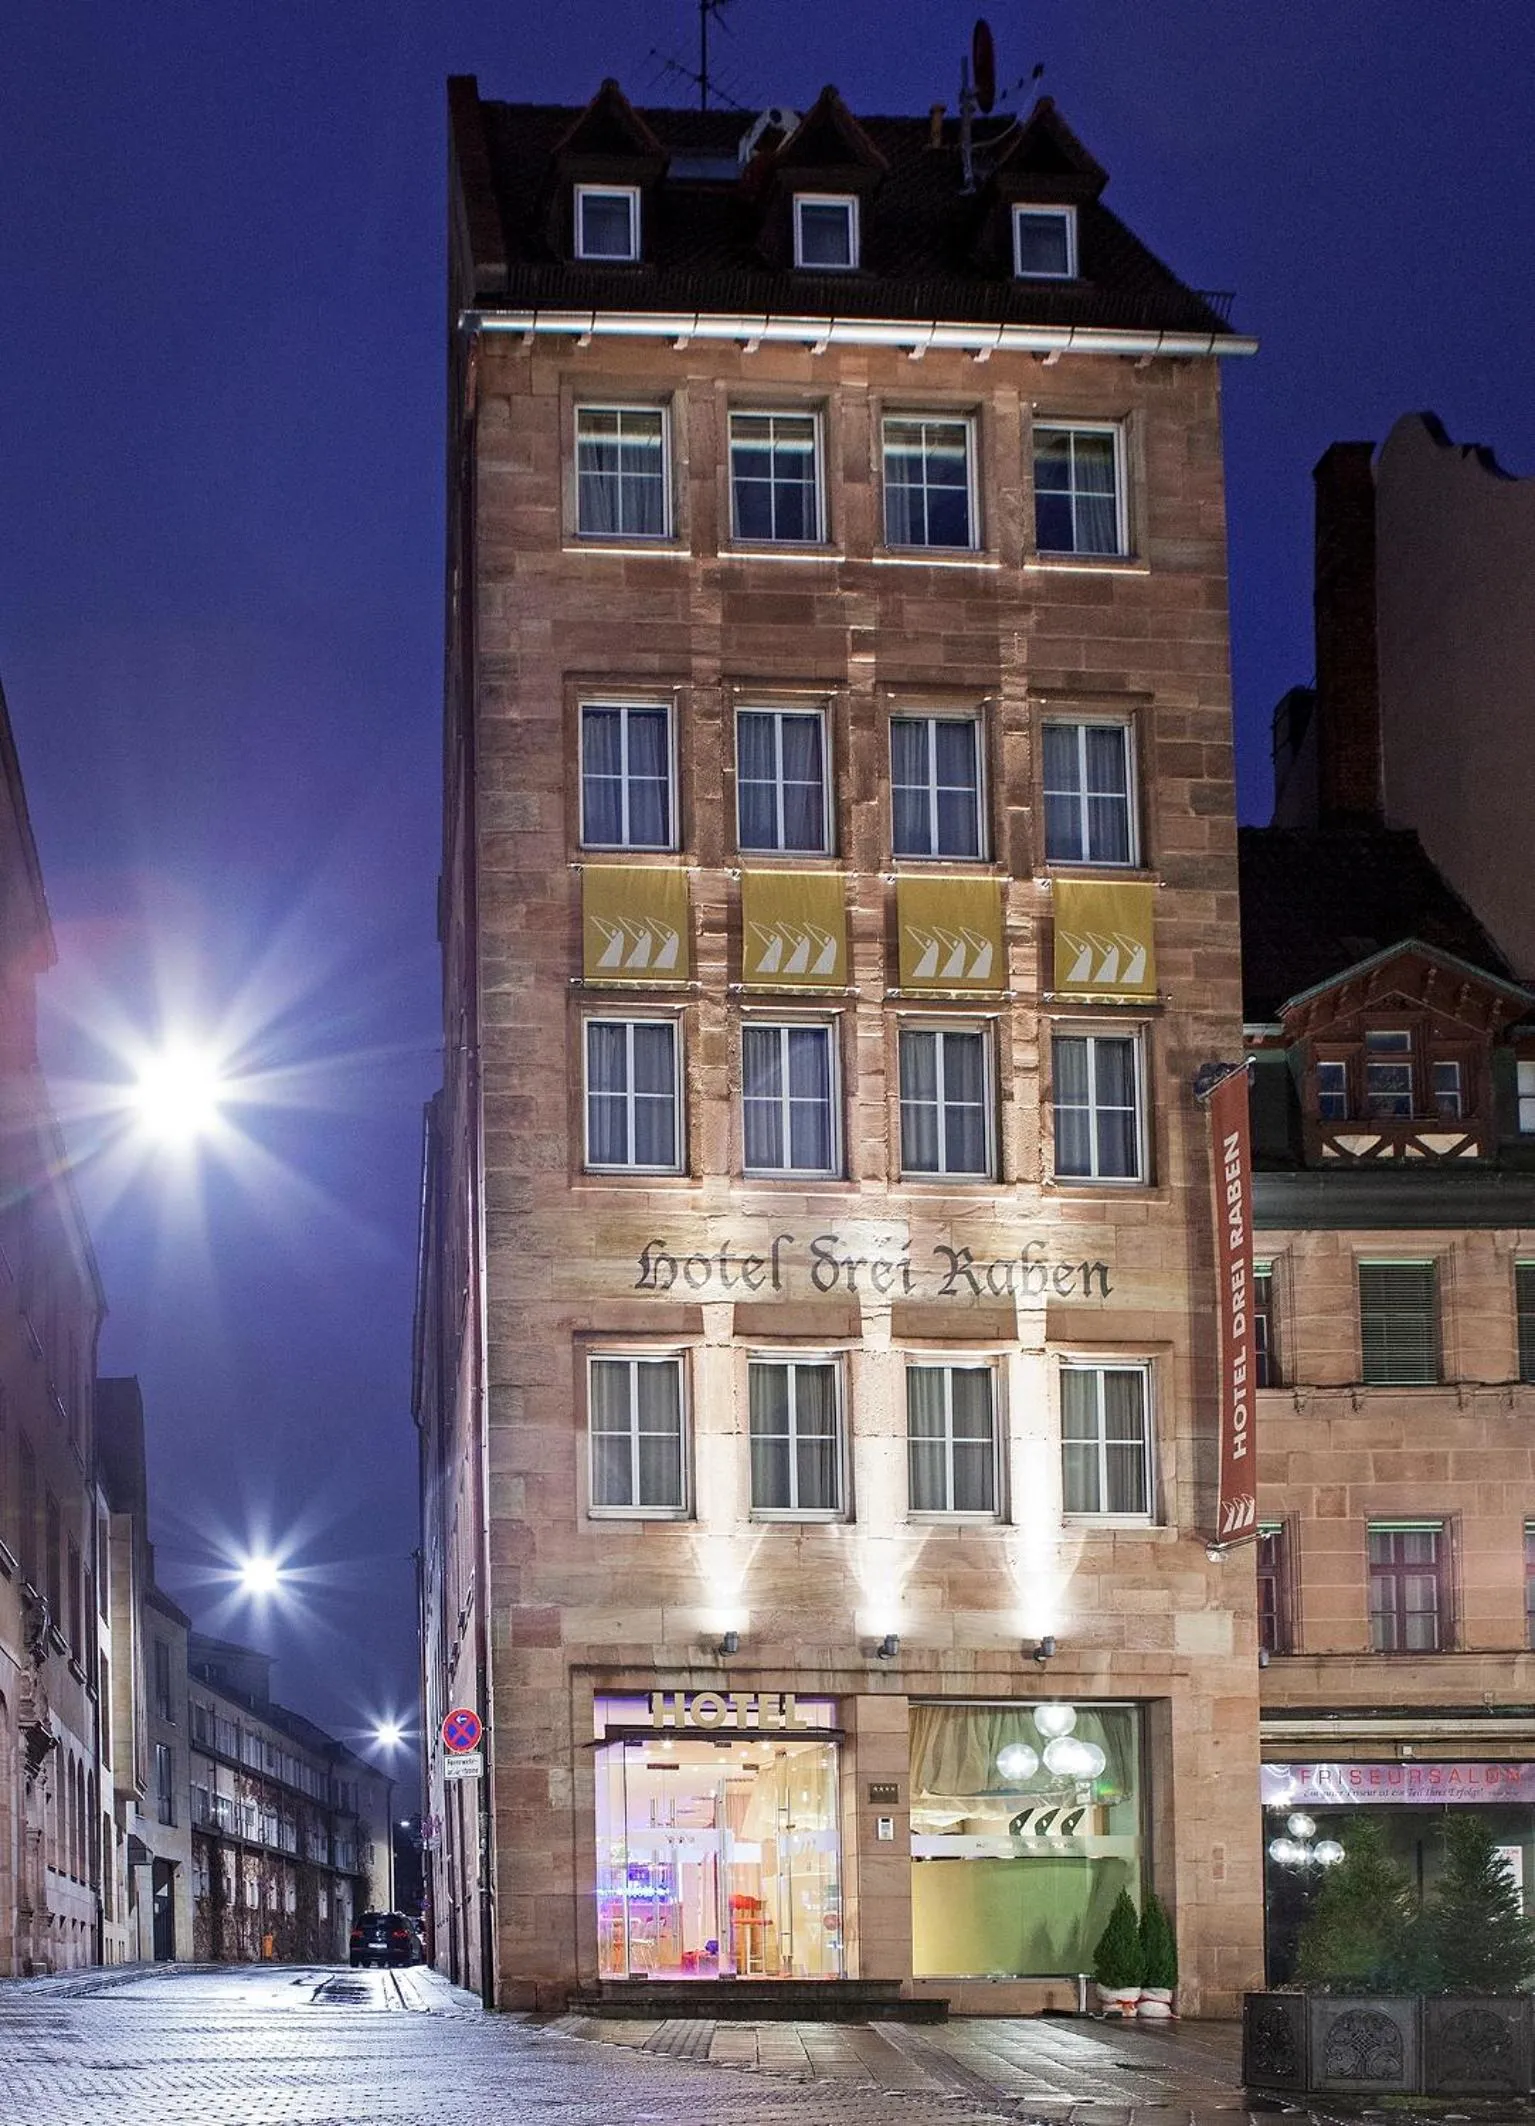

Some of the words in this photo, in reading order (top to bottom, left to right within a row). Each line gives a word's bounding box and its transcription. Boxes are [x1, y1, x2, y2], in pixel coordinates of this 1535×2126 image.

[1223, 1131, 1243, 1249] RABEN
[634, 1234, 795, 1293] Hotel
[934, 1239, 1114, 1299] Raben
[1231, 1258, 1246, 1338] DREI
[1232, 1344, 1248, 1460] HOTEL
[652, 1691, 808, 1730] HOTEL
